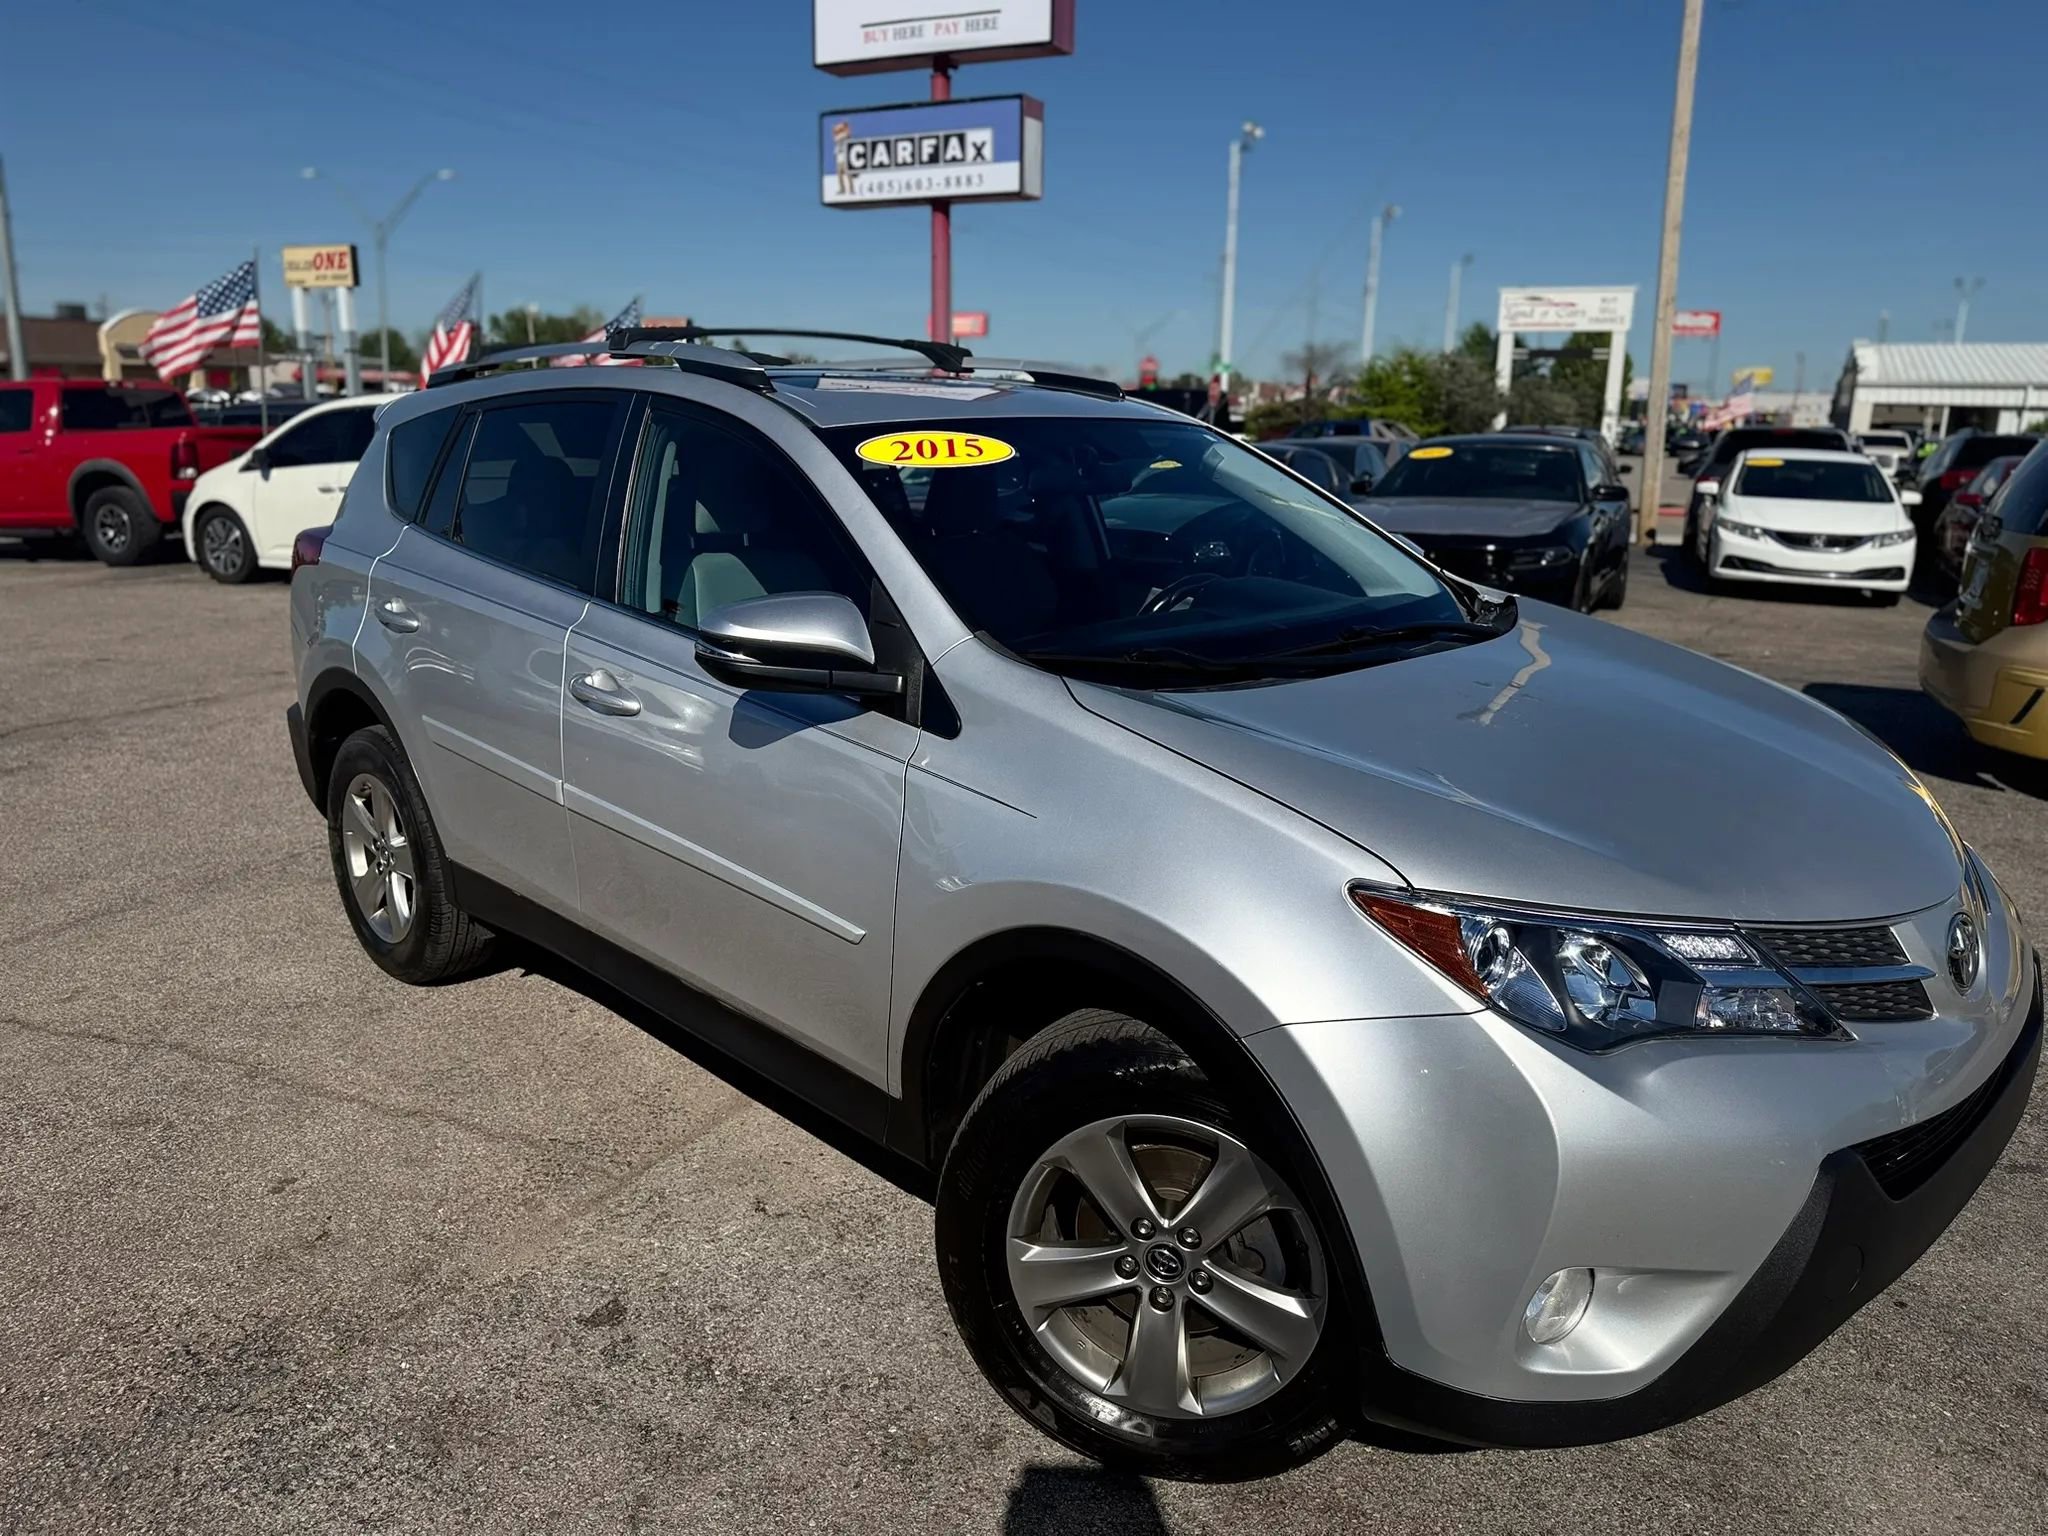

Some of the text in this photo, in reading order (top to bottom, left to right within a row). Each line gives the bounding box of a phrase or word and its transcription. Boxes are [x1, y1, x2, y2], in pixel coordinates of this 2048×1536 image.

[863, 16, 999, 44] BUY HERE PAY HERE
[848, 134, 988, 169] CARFAX
[313, 251, 348, 271] ONE
[890, 437, 984, 462] 2015
